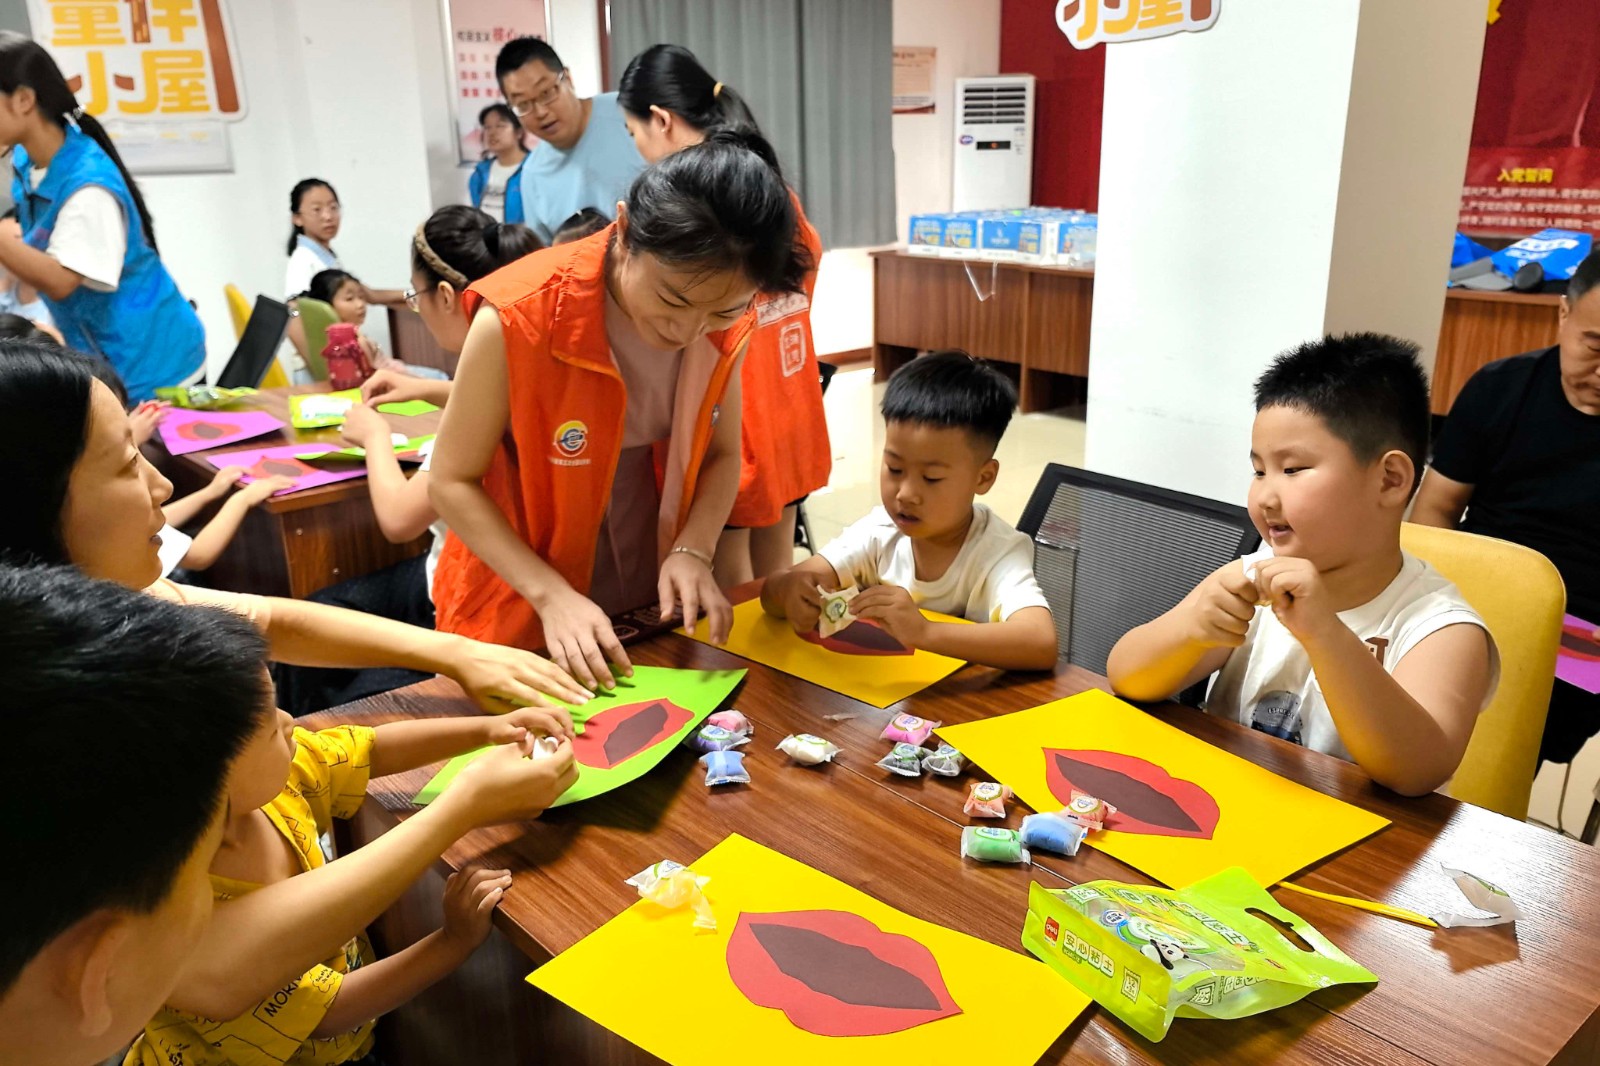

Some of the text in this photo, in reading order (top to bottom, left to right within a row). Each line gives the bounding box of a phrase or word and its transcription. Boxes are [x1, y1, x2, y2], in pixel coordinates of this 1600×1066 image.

[65, 50, 211, 116] 小屋
[1065, 933, 1114, 974] 安心粘土
